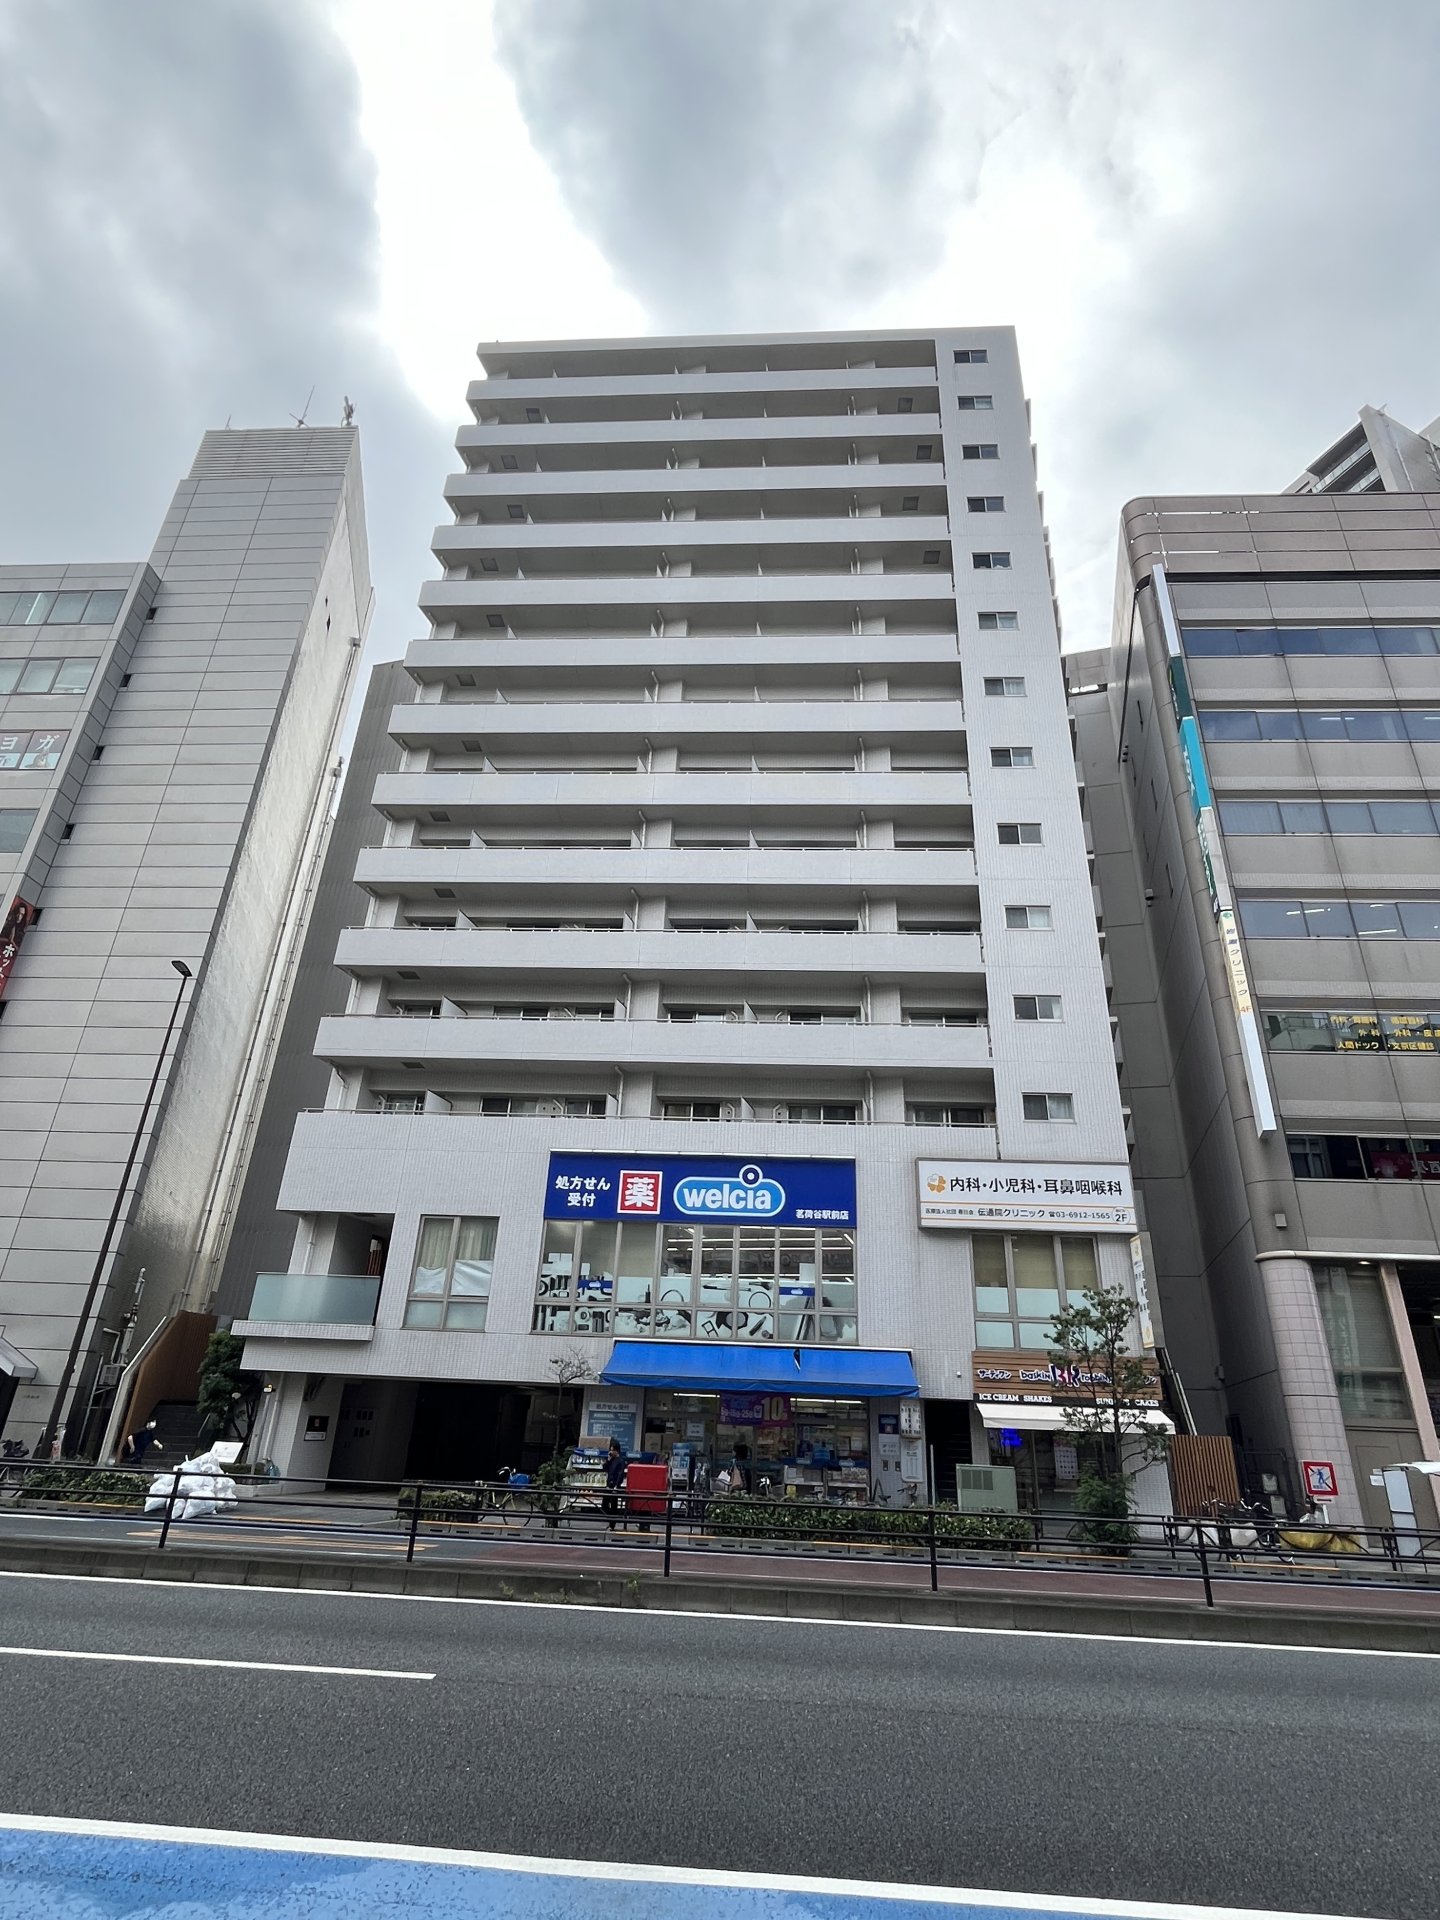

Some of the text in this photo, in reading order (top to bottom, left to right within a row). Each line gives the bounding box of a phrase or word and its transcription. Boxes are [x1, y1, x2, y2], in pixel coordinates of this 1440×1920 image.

[555, 1175, 611, 1191] 処方せん
[949, 1175, 1123, 1197] 内科・小児科・耳鼻咽喉科
[567, 1192, 596, 1207] 受付
[624, 1176, 655, 1208] 薬
[682, 1180, 772, 1210] welcia
[795, 1208, 850, 1220] 茗荷谷駅前店
[977, 1208, 1045, 1219] 伝通院クリニック
[1114, 1213, 1128, 1222] 2F
[977, 1369, 1012, 1379] サーティワン
[1019, 1369, 1051, 1382] baskin
[978, 1392, 1160, 1407] ICE CREAM SHAKES SUNS CAKES
